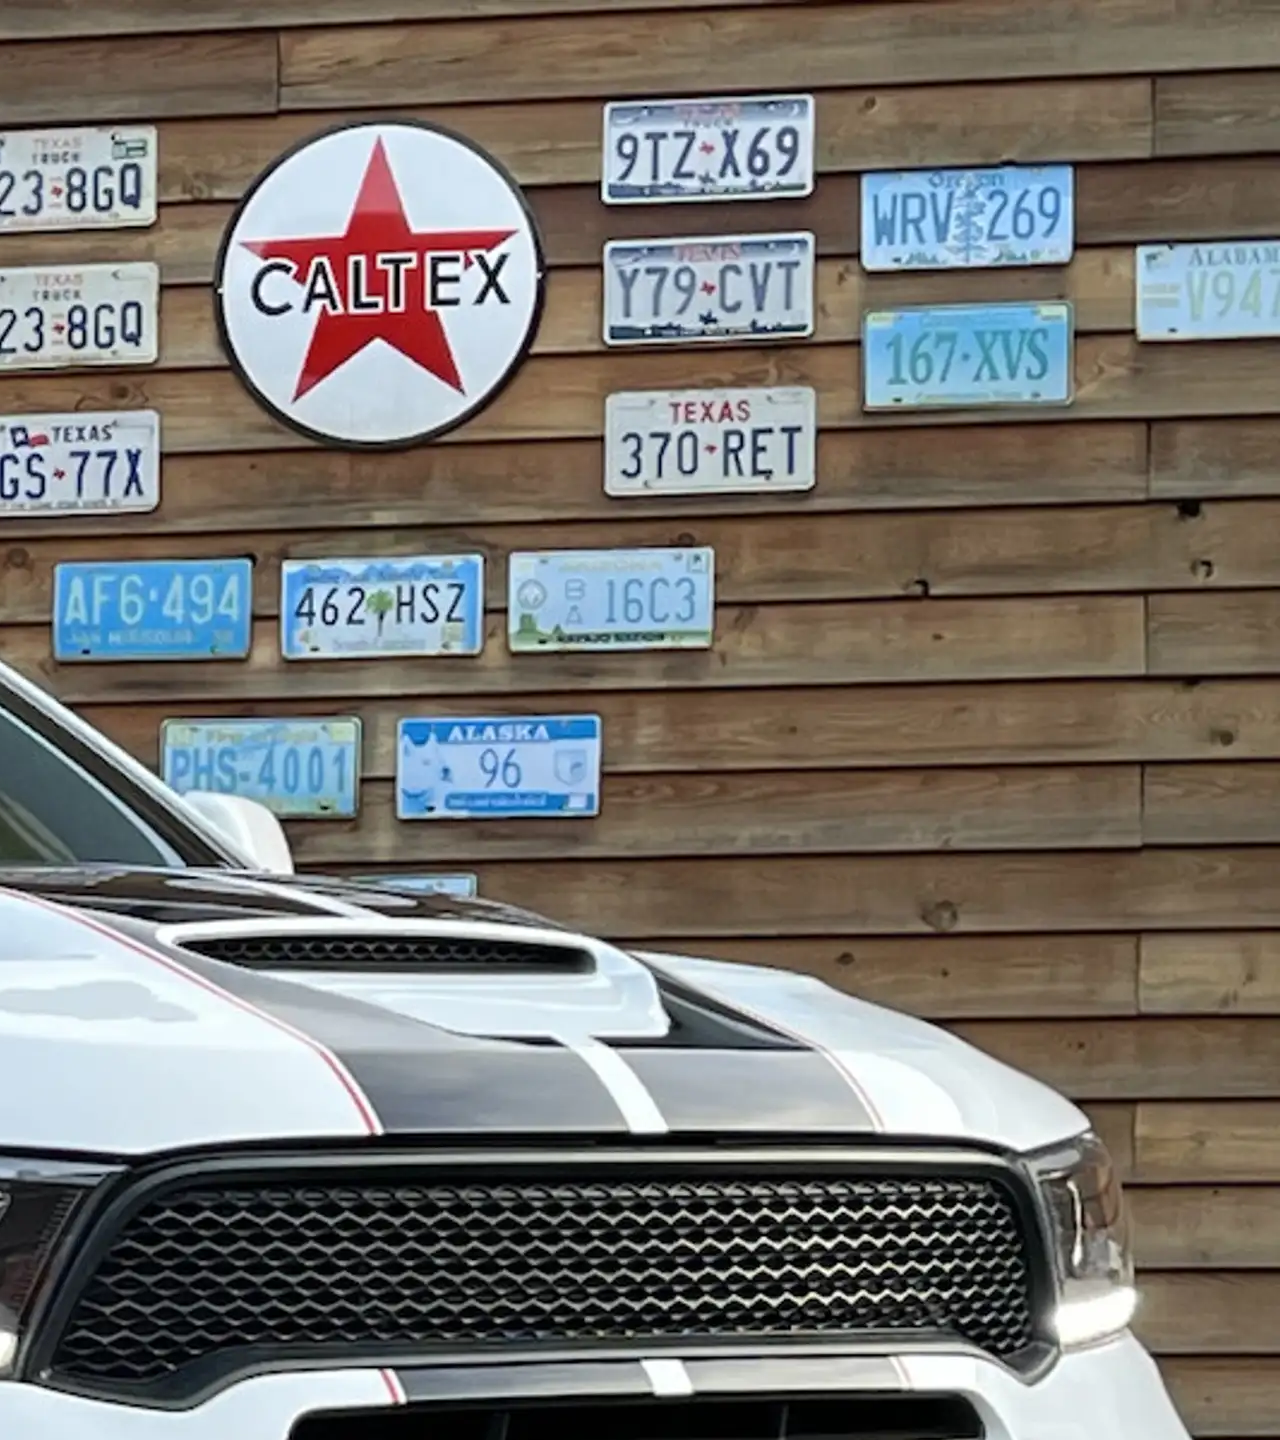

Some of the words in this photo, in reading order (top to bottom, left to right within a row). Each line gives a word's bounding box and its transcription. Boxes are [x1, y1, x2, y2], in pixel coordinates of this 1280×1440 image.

[615, 131, 697, 182] 9TZ
[718, 125, 800, 179] X69
[65, 162, 142, 213] 8GQ
[872, 190, 953, 246] WRV
[986, 185, 1062, 243] 269
[250, 252, 511, 317] CALTEX
[618, 265, 697, 318] Y79
[719, 260, 801, 314] CVT
[66, 300, 143, 349] 8GQ
[51, 425, 113, 443] TEXAS
[668, 399, 751, 424] TEXAS
[69, 448, 144, 499] 77X
[619, 430, 699, 479] 370
[722, 425, 803, 478] RET
[294, 586, 366, 627] 462
[395, 582, 467, 625] HSZ
[447, 724, 550, 743] ALASKA
[479, 748, 522, 789] 96
